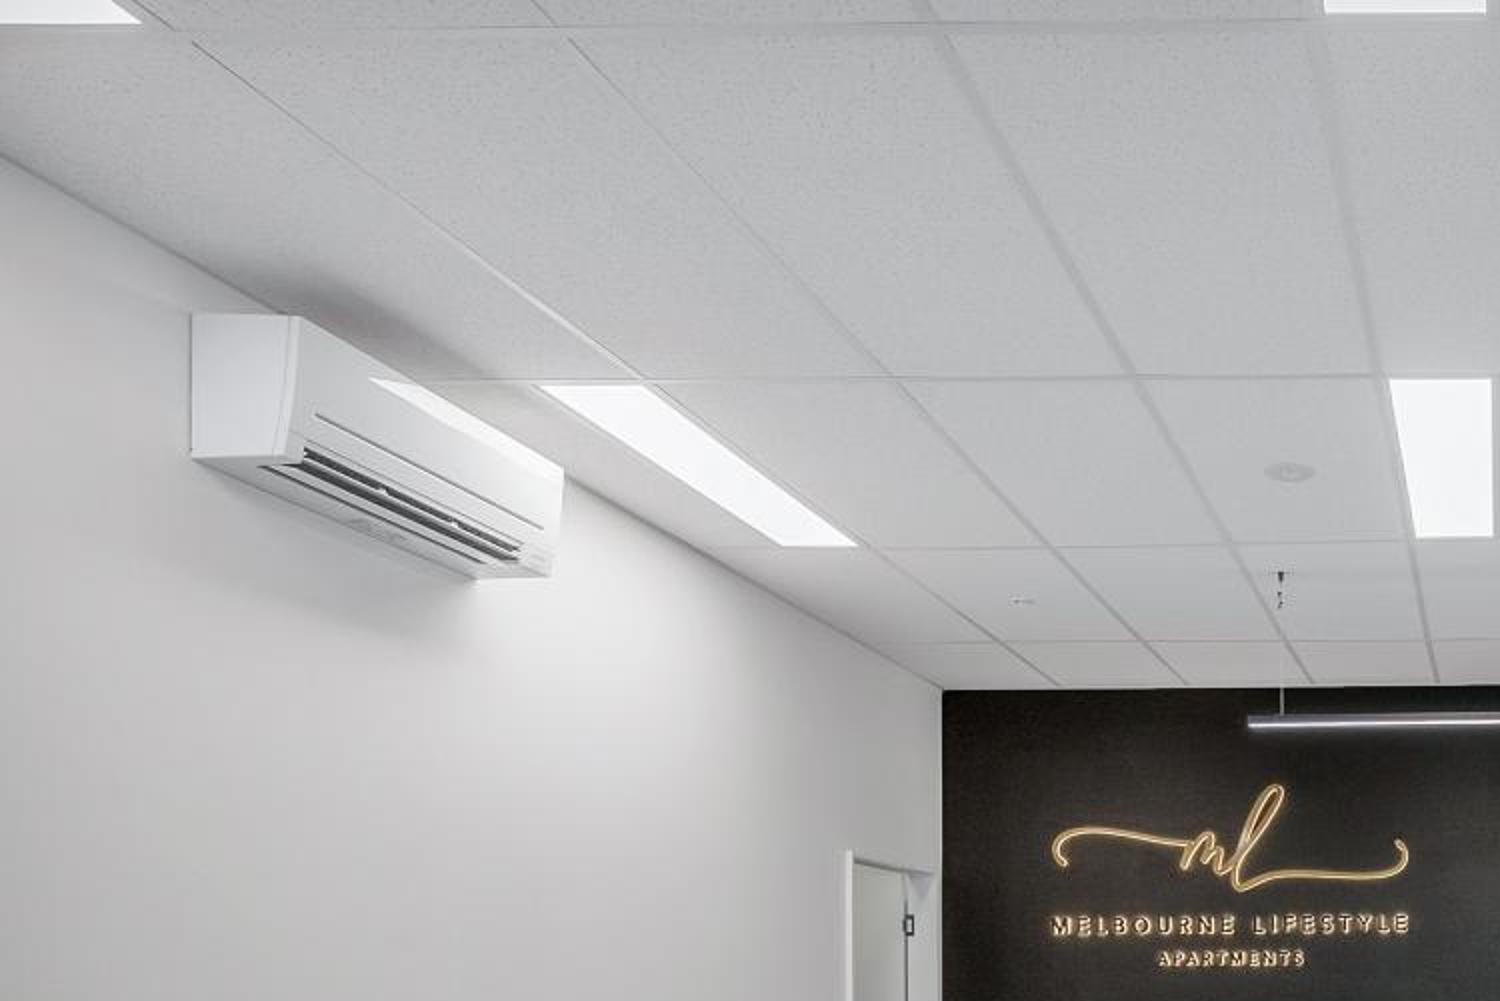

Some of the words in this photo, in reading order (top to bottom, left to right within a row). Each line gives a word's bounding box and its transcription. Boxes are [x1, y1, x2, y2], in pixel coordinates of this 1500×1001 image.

[1051, 914, 1236, 938] MELBOURNE
[1253, 912, 1410, 936] LIFESTYLE
[1156, 947, 1307, 968] APARTMENTS
